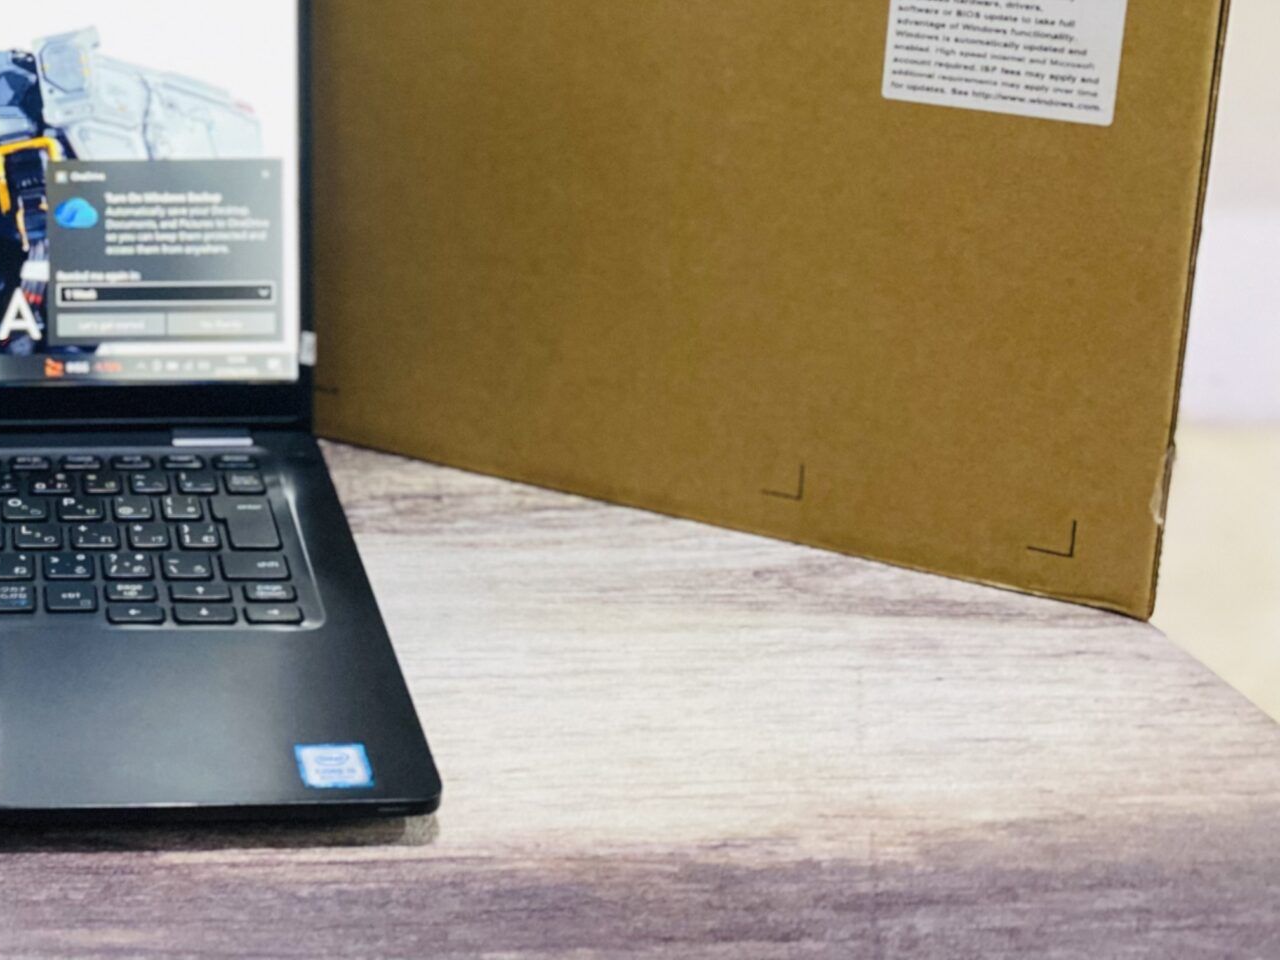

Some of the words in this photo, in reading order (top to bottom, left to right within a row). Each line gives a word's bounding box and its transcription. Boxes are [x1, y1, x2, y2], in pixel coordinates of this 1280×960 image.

[898, 3, 939, 14] software
[955, 9, 980, 18] BIOS
[1034, 18, 1055, 26] take
[1058, 20, 1075, 28] full
[962, 23, 1007, 35] Windows
[895, 29, 939, 40] Windows
[1023, 43, 1065, 56] updated
[1067, 48, 1087, 57] and
[1028, 58, 1046, 66] and
[893, 55, 931, 66] account
[1024, 72, 1045, 81] may
[1048, 73, 1076, 85] apply
[1080, 77, 1099, 86] and
[890, 80, 903, 88] for
[1000, 82, 1020, 91] may
[1023, 83, 1048, 94] apply
